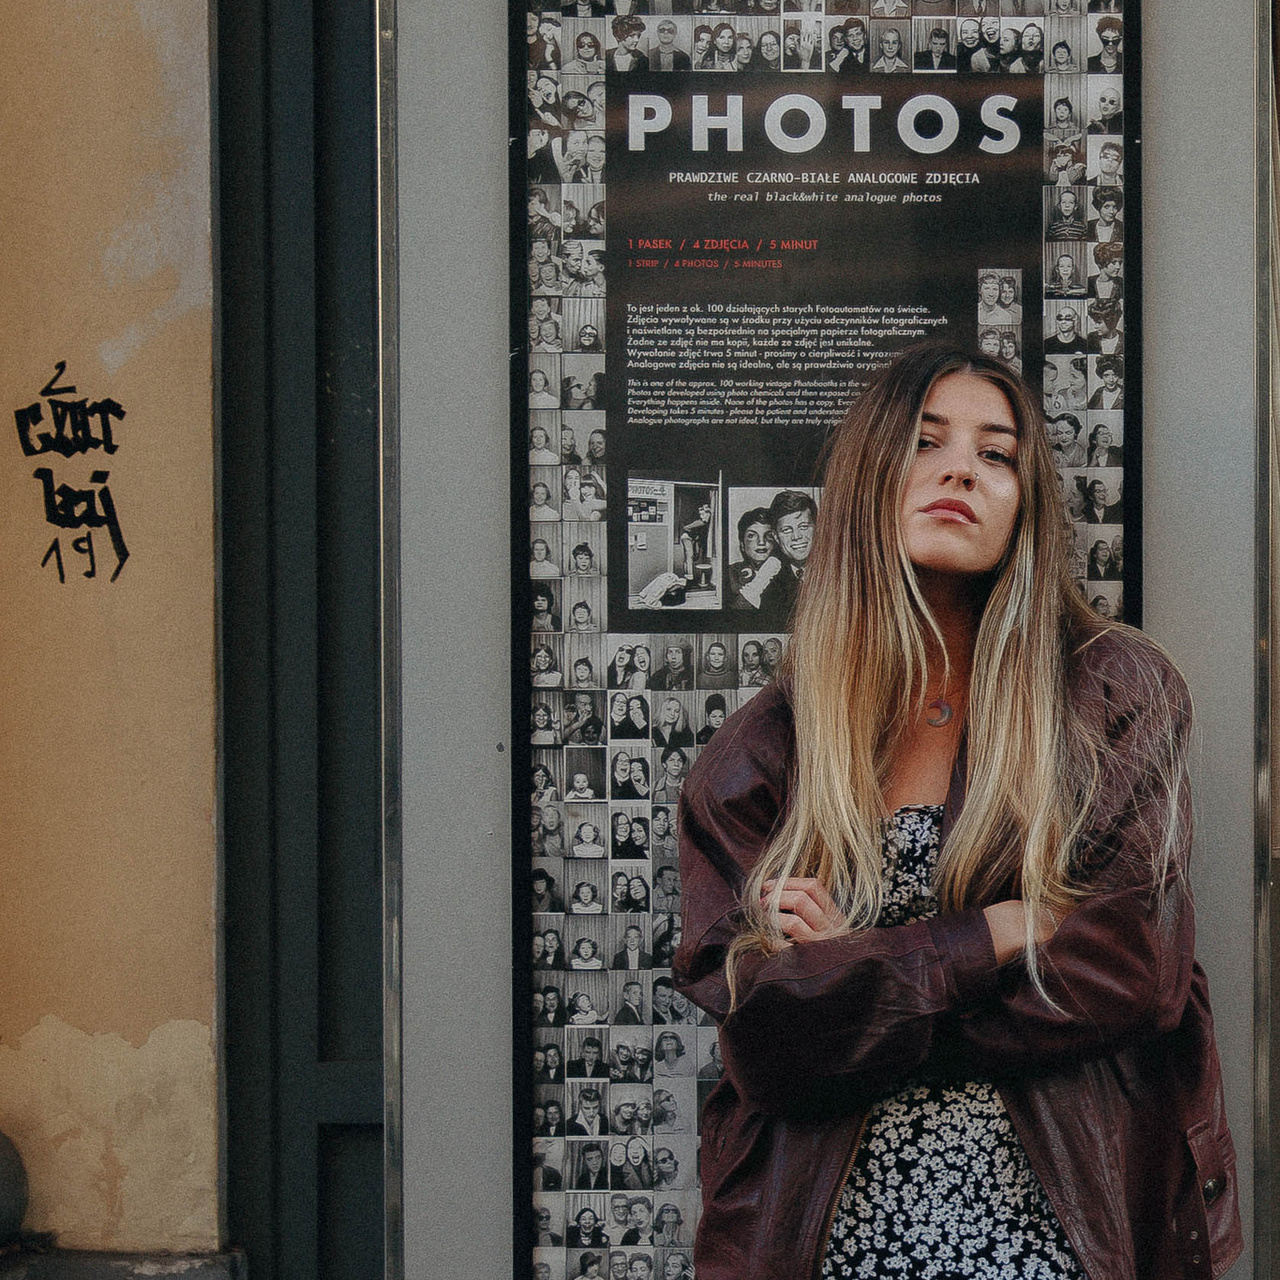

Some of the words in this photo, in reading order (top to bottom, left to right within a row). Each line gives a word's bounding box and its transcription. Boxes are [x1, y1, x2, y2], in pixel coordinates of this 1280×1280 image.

[627, 93, 1021, 154] PHOTOS
[669, 171, 739, 184] PRAWDZIWE
[746, 171, 840, 184] CZARNO-BIAŁE
[847, 172, 918, 184] ANALOGOWE
[925, 172, 980, 186] ZDJĘCIA
[707, 191, 728, 202] the
[733, 191, 759, 202] real
[765, 191, 839, 202] black&white
[843, 191, 897, 205] analogue
[902, 192, 942, 204] photos
[637, 238, 673, 250] PASEK
[692, 239, 701, 249] 4
[703, 238, 750, 253] ZDJĘCIA
[769, 239, 777, 250] 5
[779, 238, 818, 250] MINUT
